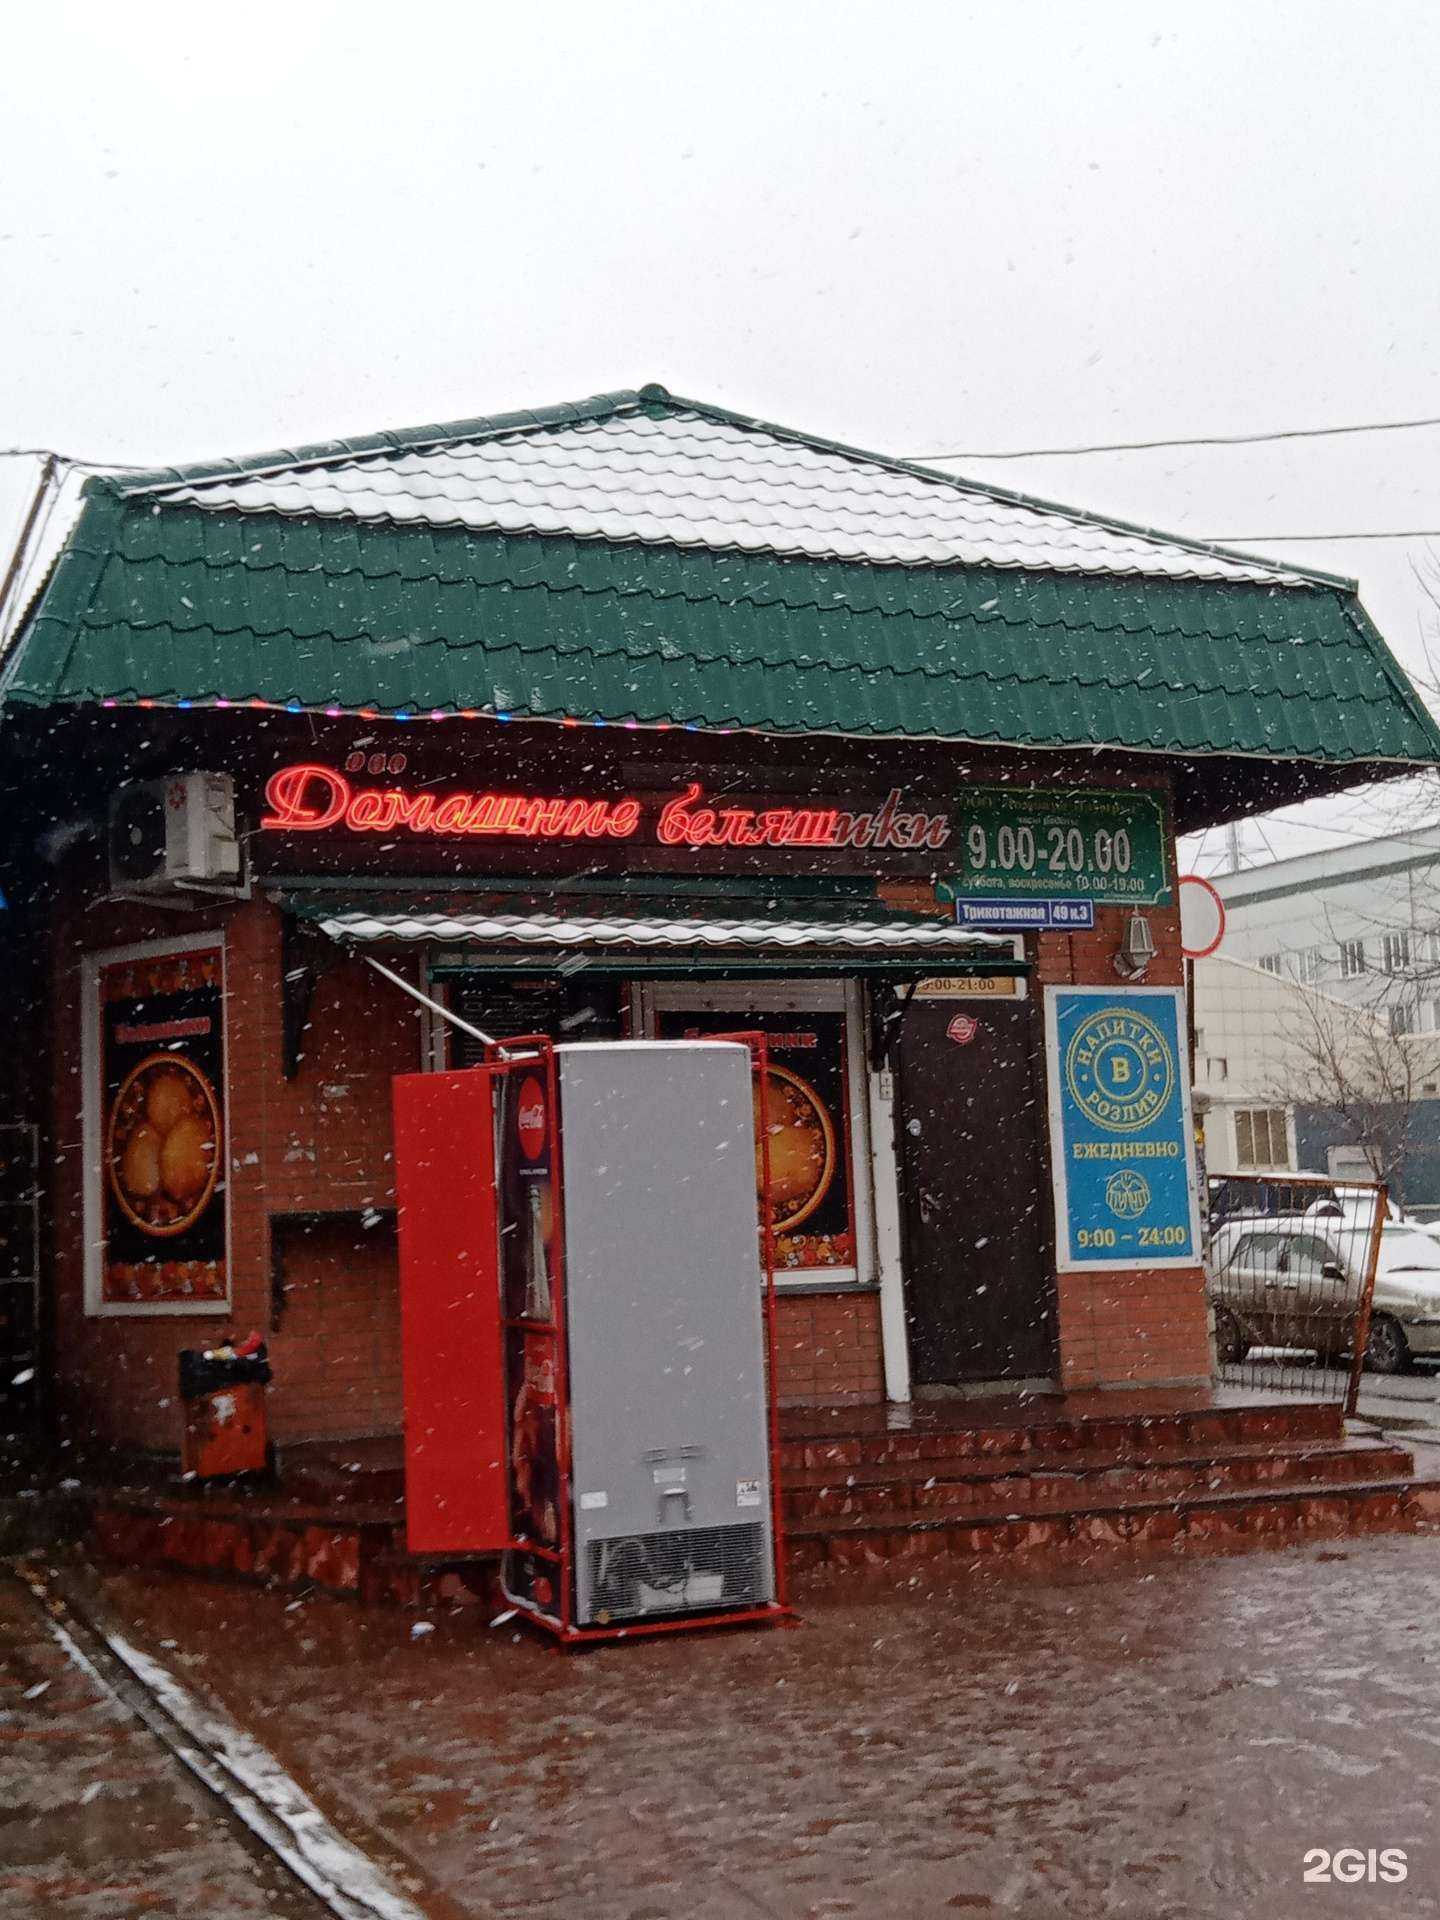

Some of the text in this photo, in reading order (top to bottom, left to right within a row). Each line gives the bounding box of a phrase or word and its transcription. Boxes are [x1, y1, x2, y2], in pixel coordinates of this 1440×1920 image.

[260, 765, 951, 848] Домашние беляшики
[968, 824, 1132, 874] 9.00-20.00
[962, 904, 1045, 920] Трикотажная
[1053, 905, 1068, 920] 49
[1077, 1019, 1163, 1066] НАПИТКИ
[1112, 1057, 1131, 1083] В
[1086, 1090, 1160, 1122] РОЗЛИВ
[1073, 1141, 1179, 1161] ЕЖЕДНЕВНО
[1077, 1228, 1116, 1248] 9:00
[1138, 1227, 1187, 1247] 24:00
